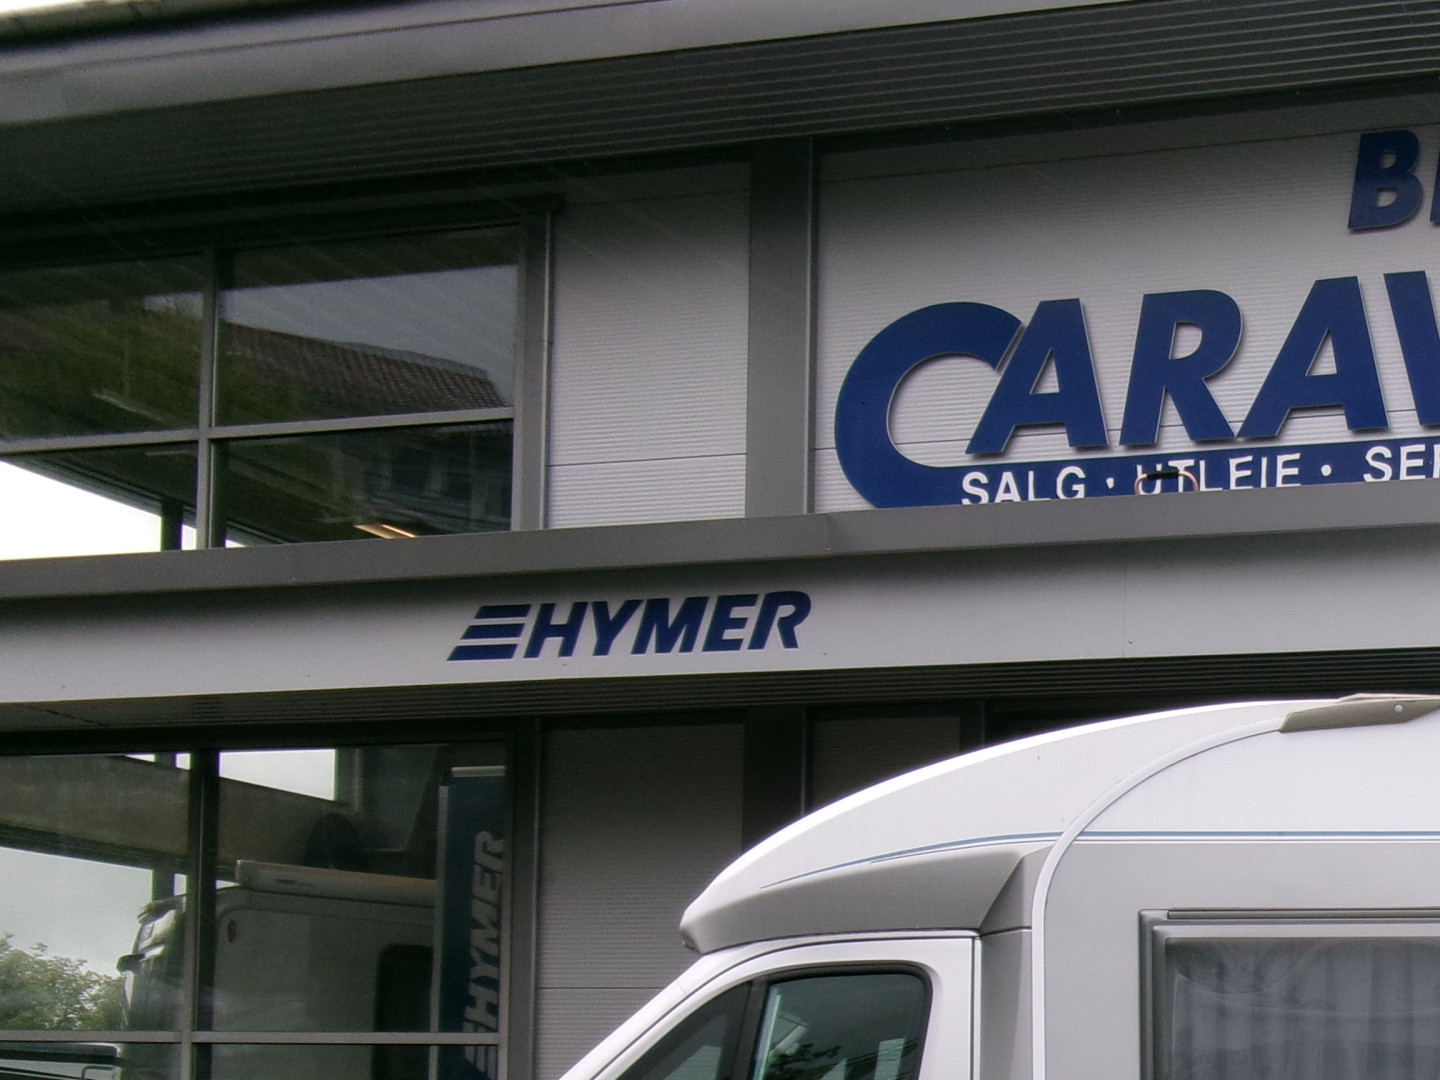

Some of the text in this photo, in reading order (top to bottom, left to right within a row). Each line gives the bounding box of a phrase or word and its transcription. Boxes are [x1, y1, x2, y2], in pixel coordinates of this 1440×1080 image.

[961, 466, 1087, 506] SALG
[1136, 453, 1302, 496] UTLEIE
[523, 591, 812, 660] HYMER
[464, 830, 506, 1026] HYMER
